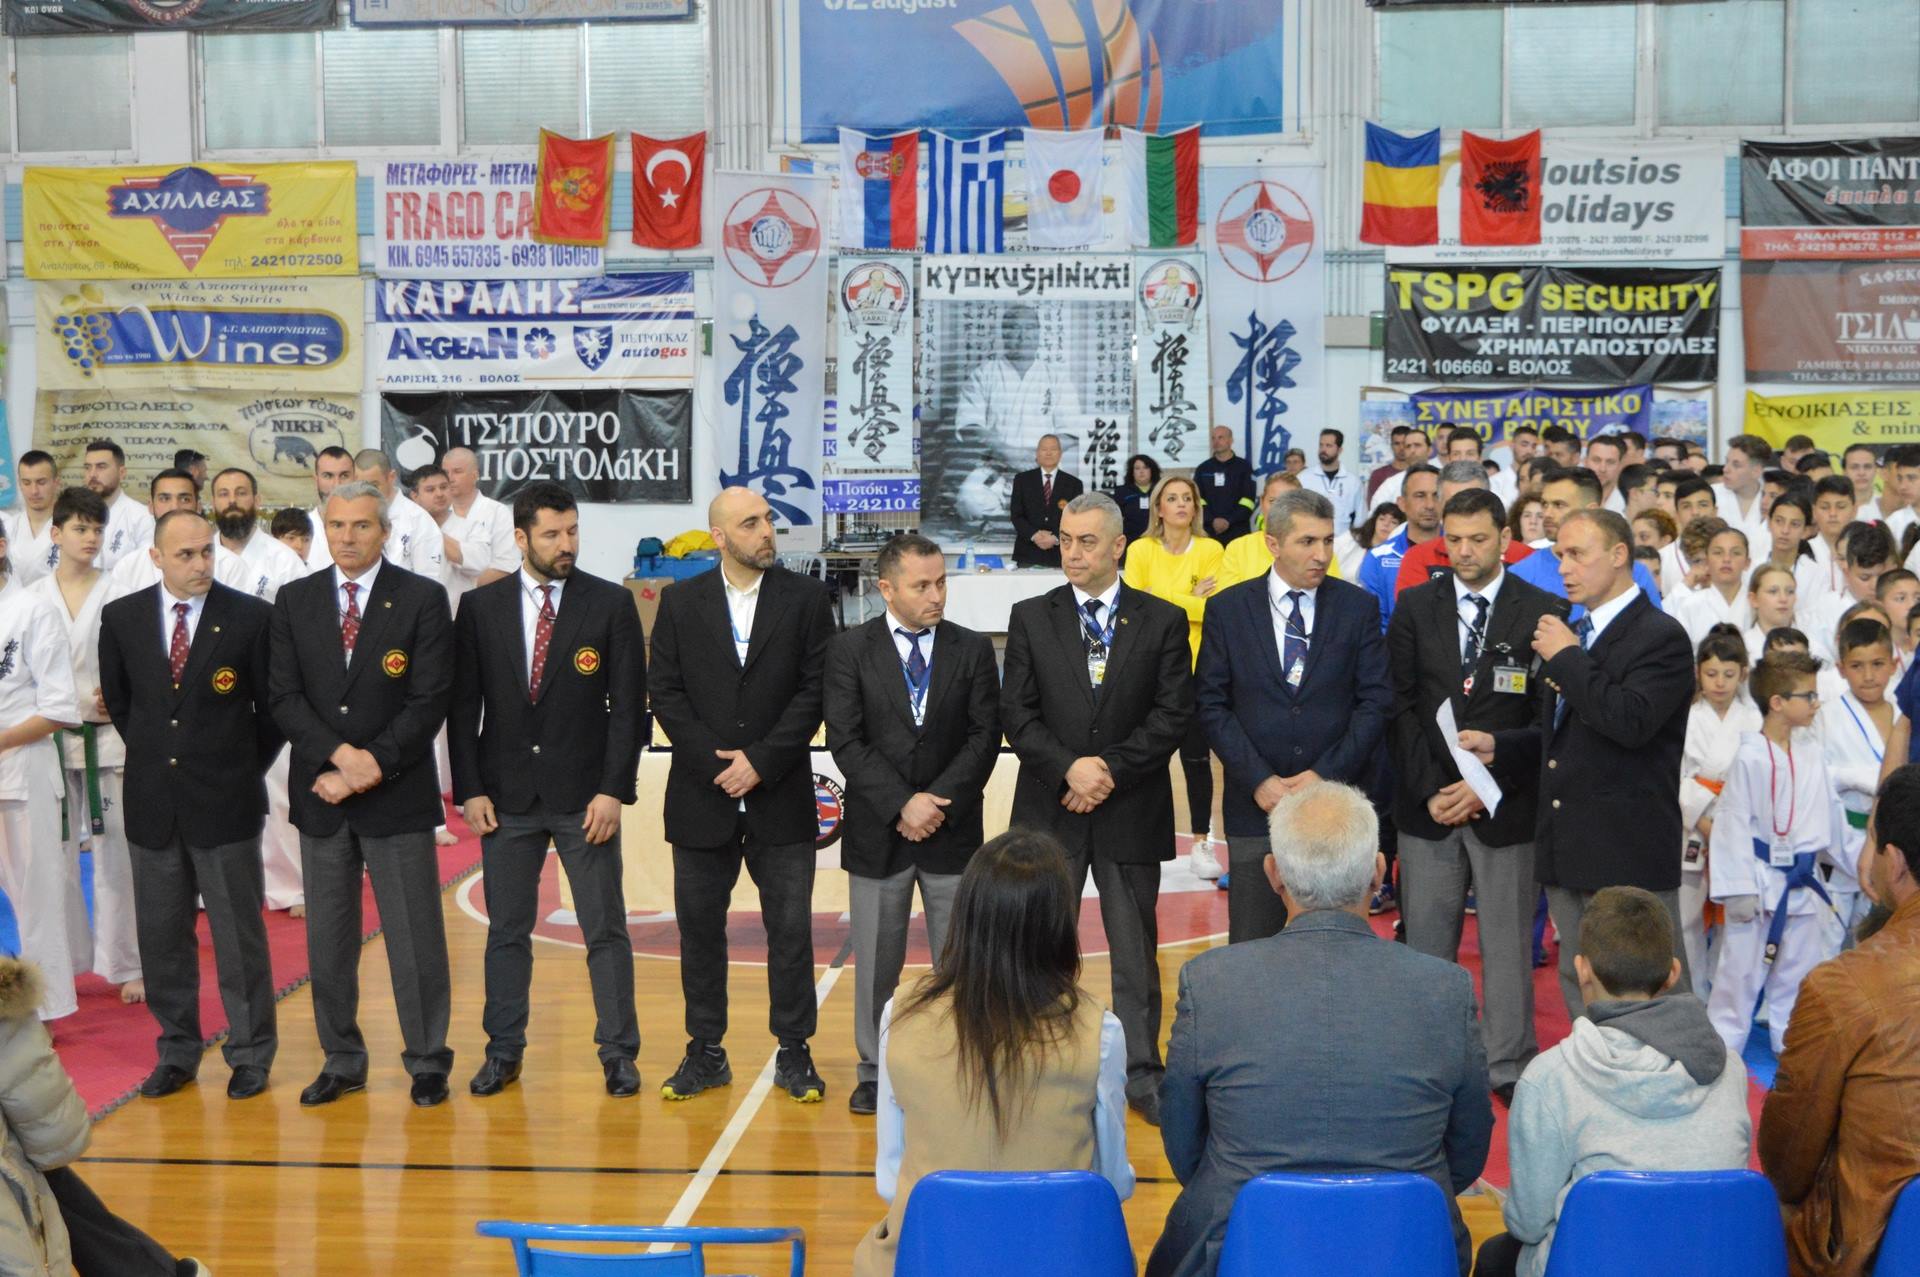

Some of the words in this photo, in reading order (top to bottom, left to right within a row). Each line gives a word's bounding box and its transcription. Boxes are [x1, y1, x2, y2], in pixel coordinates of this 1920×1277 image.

[386, 163, 478, 186] ΜΕΤΑΦΟΡΕΣ
[1540, 156, 1681, 186] outsios
[385, 191, 486, 241] FRAGO
[494, 191, 535, 241] CA
[1540, 195, 1675, 231] olidays
[250, 254, 344, 267] 2421072500
[415, 246, 449, 267] 6945
[452, 246, 501, 267] 557335
[512, 246, 547, 266] 6938
[550, 245, 600, 267] 105050
[926, 261, 1130, 297] KYOKUSHINKAI
[159, 293, 207, 303] Wines
[231, 293, 283, 305] Spirits
[384, 280, 582, 316] ΚΑΡΑΛΗΣ
[1390, 271, 1524, 312] TSPG
[1540, 282, 1718, 312] SECURITY
[117, 303, 328, 366] Wines
[1420, 317, 1521, 335] ΦΥΛΑΞΗ
[1540, 316, 1684, 335] ΠΕΡΙΠΟΛΙΕΣ
[621, 346, 689, 360] autogas
[1476, 337, 1716, 357] ΧΡΗΜΑΤΑΠΟΣΤΟΛΕΣ
[1387, 359, 1427, 374] 2421
[1433, 359, 1493, 374] 106660
[1508, 359, 1572, 374] ΒΟΛΟΣ
[479, 375, 521, 384] ΒΟΛΟΣ
[1416, 394, 1642, 422] ΣΥΝΕΤΑΙΡΙΣΤΙΚΟ
[1753, 400, 1912, 419] ΕΝΟΙΚΙΑΣΕΙΣ
[271, 420, 325, 433] ΝΙΚΗ
[838, 482, 888, 496] Ποτόκι
[847, 498, 906, 511] 24210
